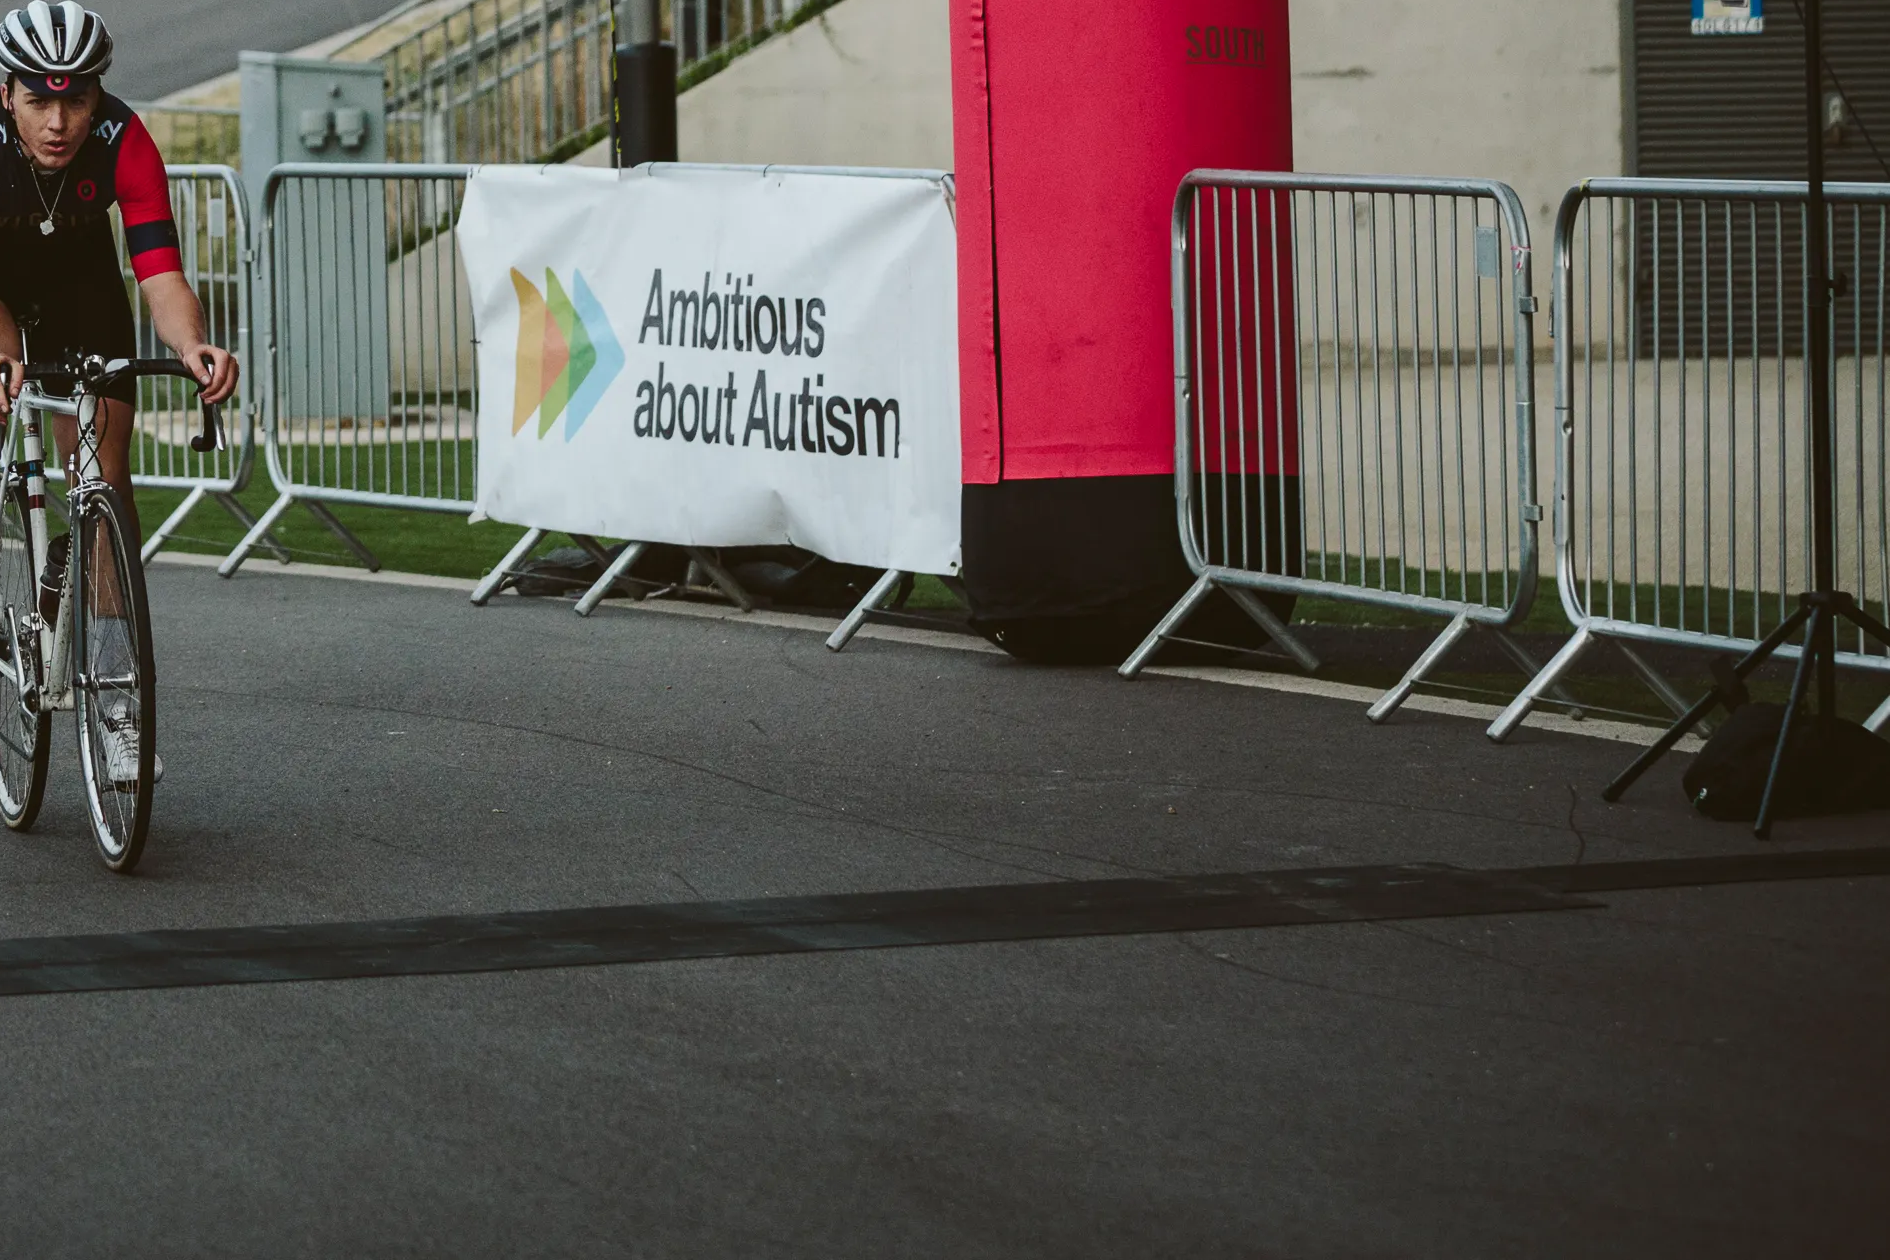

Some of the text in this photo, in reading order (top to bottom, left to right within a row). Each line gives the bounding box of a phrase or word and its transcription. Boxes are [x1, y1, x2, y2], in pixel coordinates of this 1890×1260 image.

[1185, 25, 1265, 62] SOUTH
[92, 119, 123, 146] ky
[638, 267, 826, 358] Ambitious
[634, 361, 902, 459] about Autism
